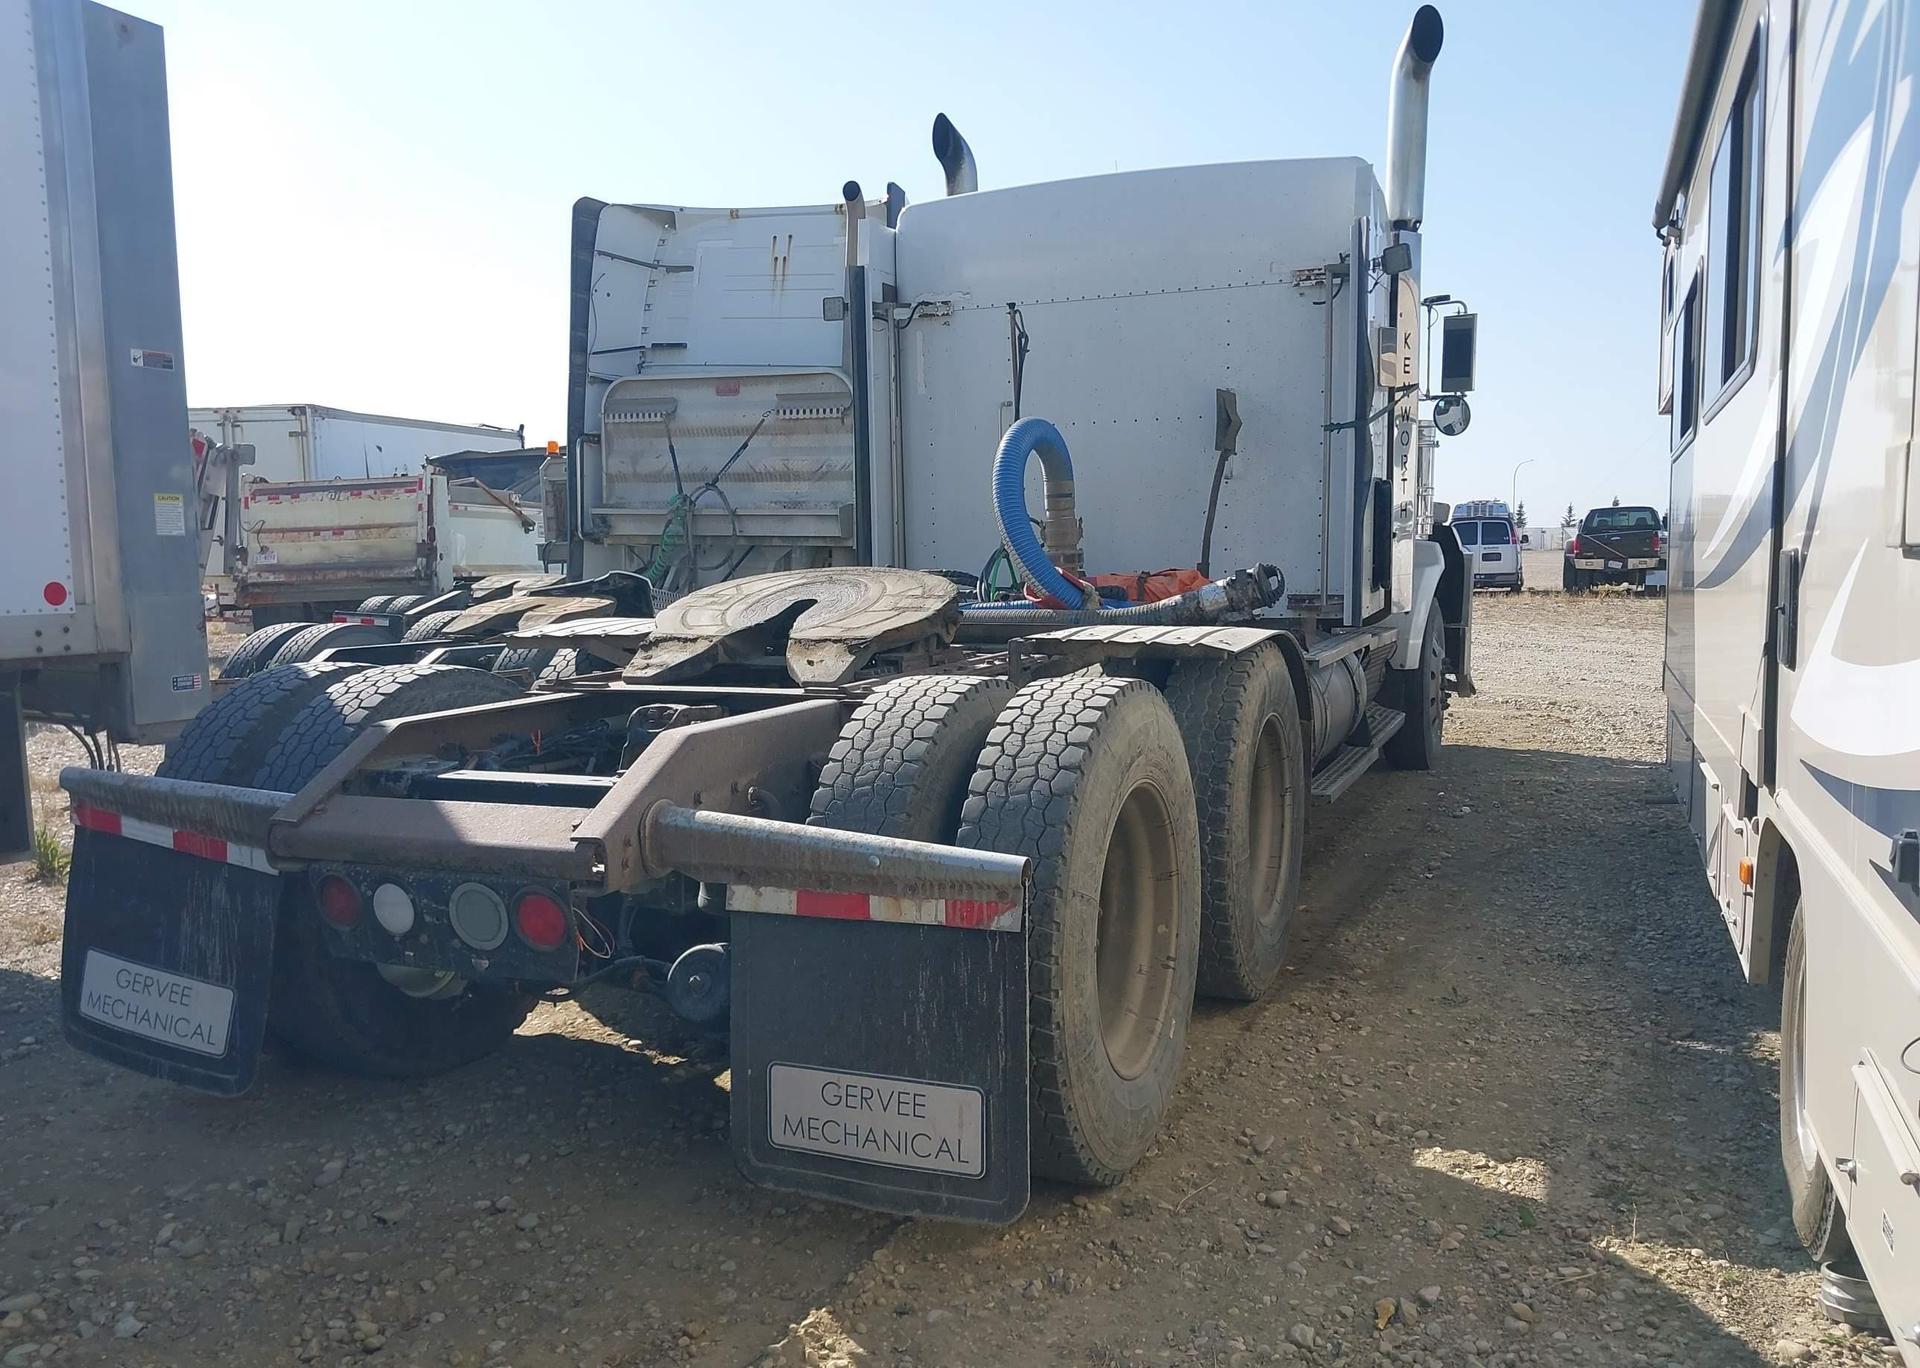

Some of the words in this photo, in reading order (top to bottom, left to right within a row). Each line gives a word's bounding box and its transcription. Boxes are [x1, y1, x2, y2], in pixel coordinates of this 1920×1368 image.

[116, 968, 193, 1006] GERVEE
[87, 992, 216, 1046] MECHANICAL
[821, 1081, 927, 1119] GERVEE
[783, 1114, 969, 1164] MECHANICAL
